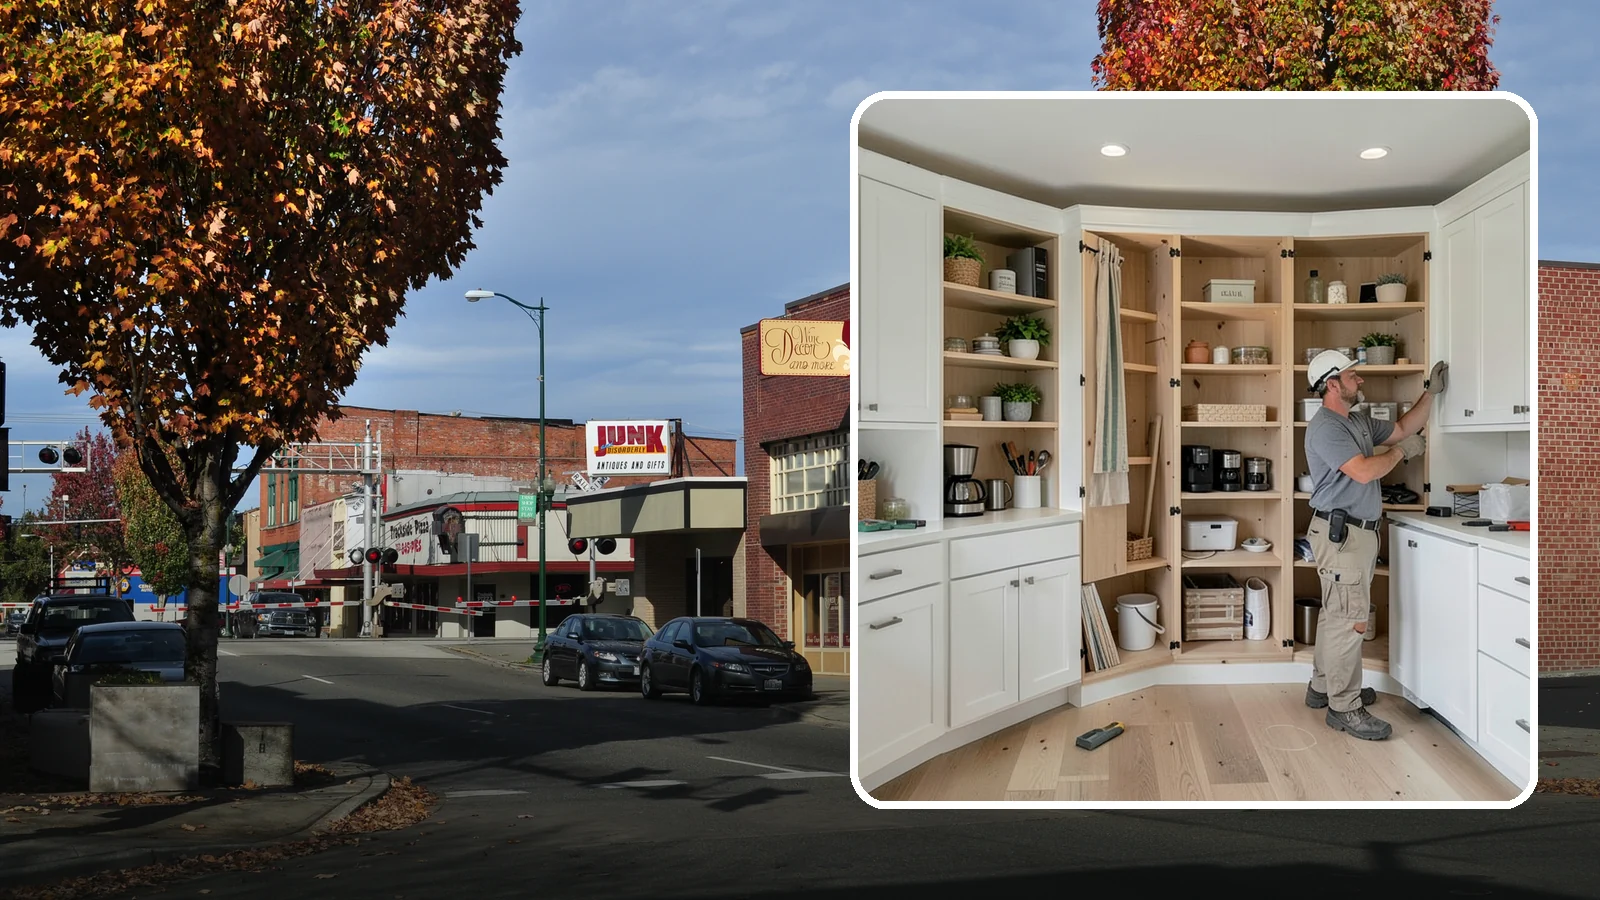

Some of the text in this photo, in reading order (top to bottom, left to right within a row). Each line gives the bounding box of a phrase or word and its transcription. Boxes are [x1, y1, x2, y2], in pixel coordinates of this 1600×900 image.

[596, 425, 664, 457] JUNK
[607, 446, 646, 454] DISORDERLY
[597, 460, 665, 470] ANTIQUES AND GIFTS
